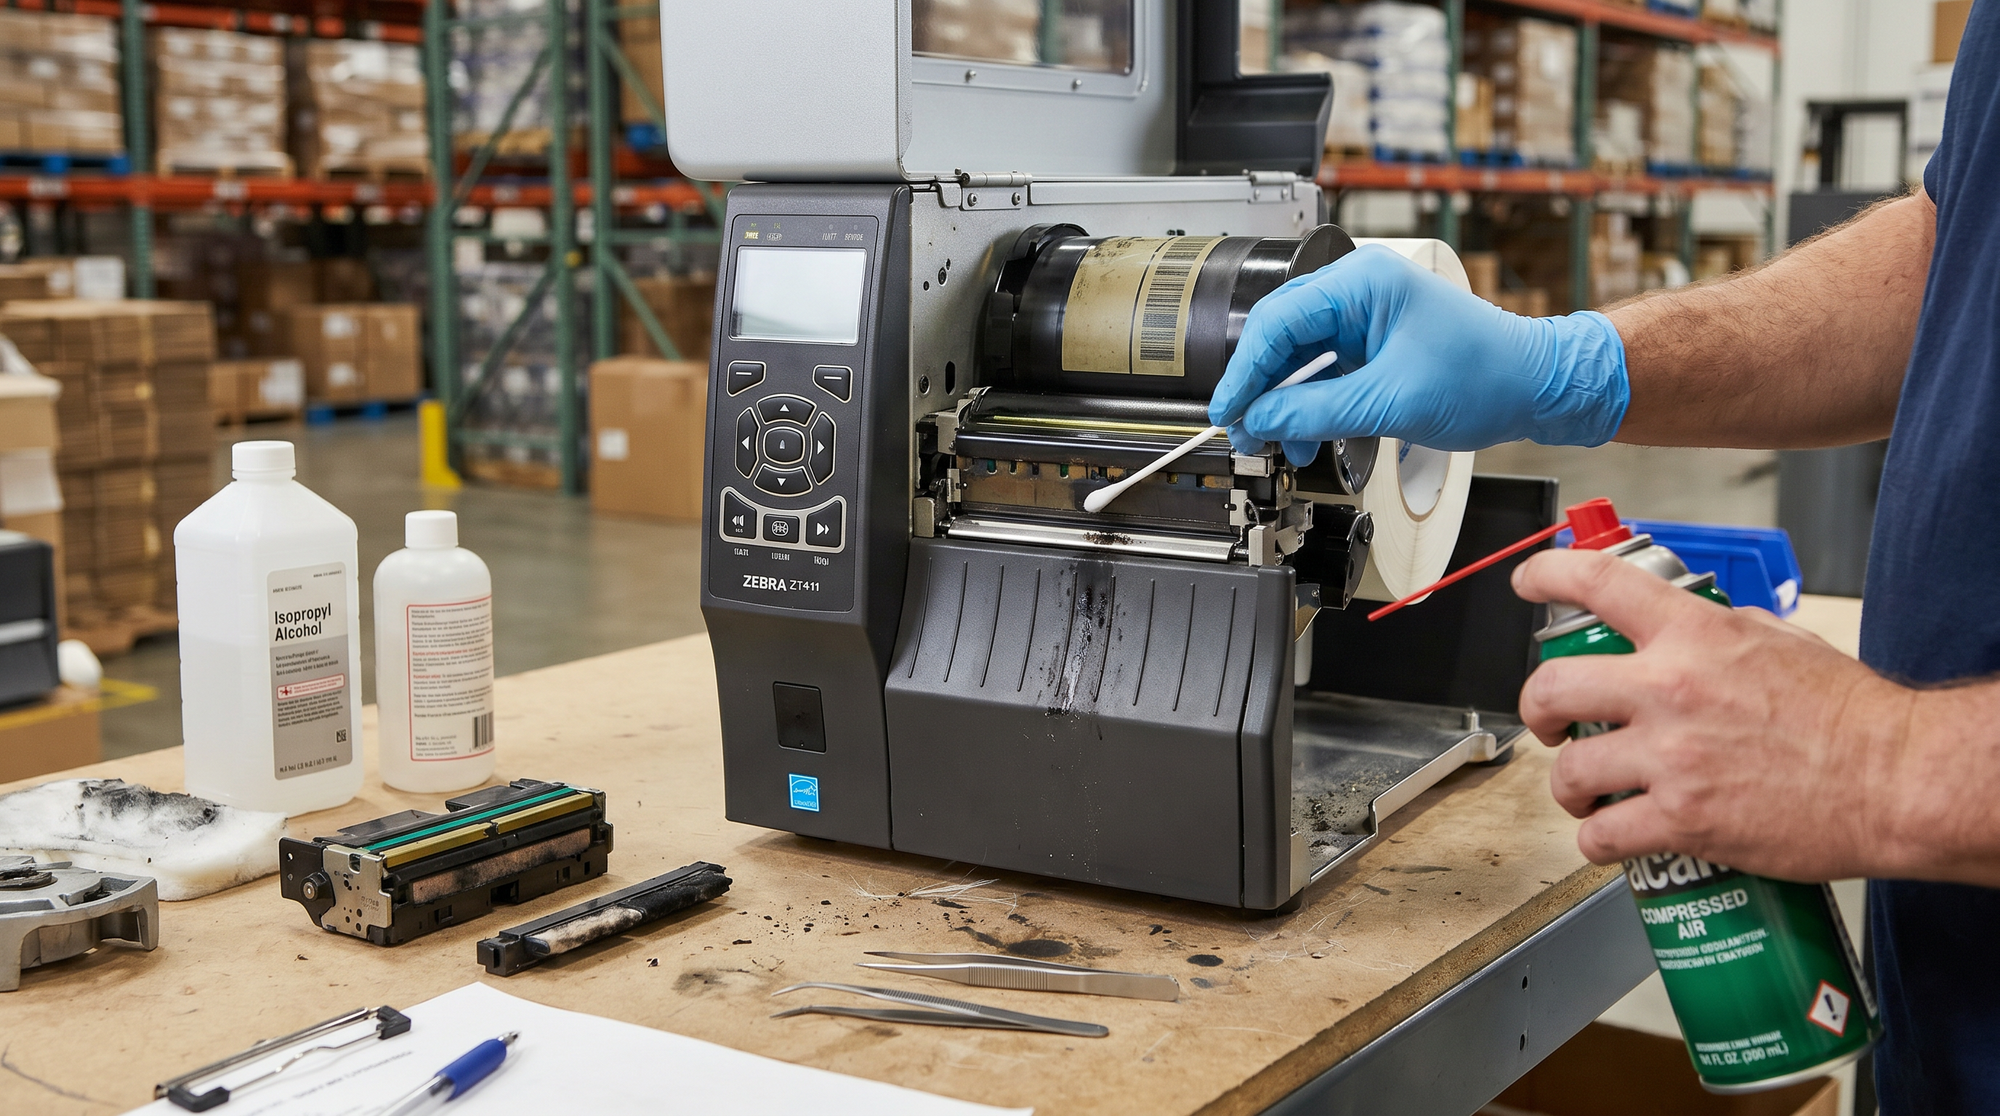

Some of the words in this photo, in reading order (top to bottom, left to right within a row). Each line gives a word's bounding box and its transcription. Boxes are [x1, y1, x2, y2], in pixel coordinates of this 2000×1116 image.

[743, 574, 787, 592] ZEBRA
[789, 580, 820, 592] ZT411
[274, 602, 331, 625] Isopropyl
[275, 621, 322, 641] Alcohol
[1641, 888, 1748, 925] COMPRESSED
[1678, 919, 1707, 941] AIR
